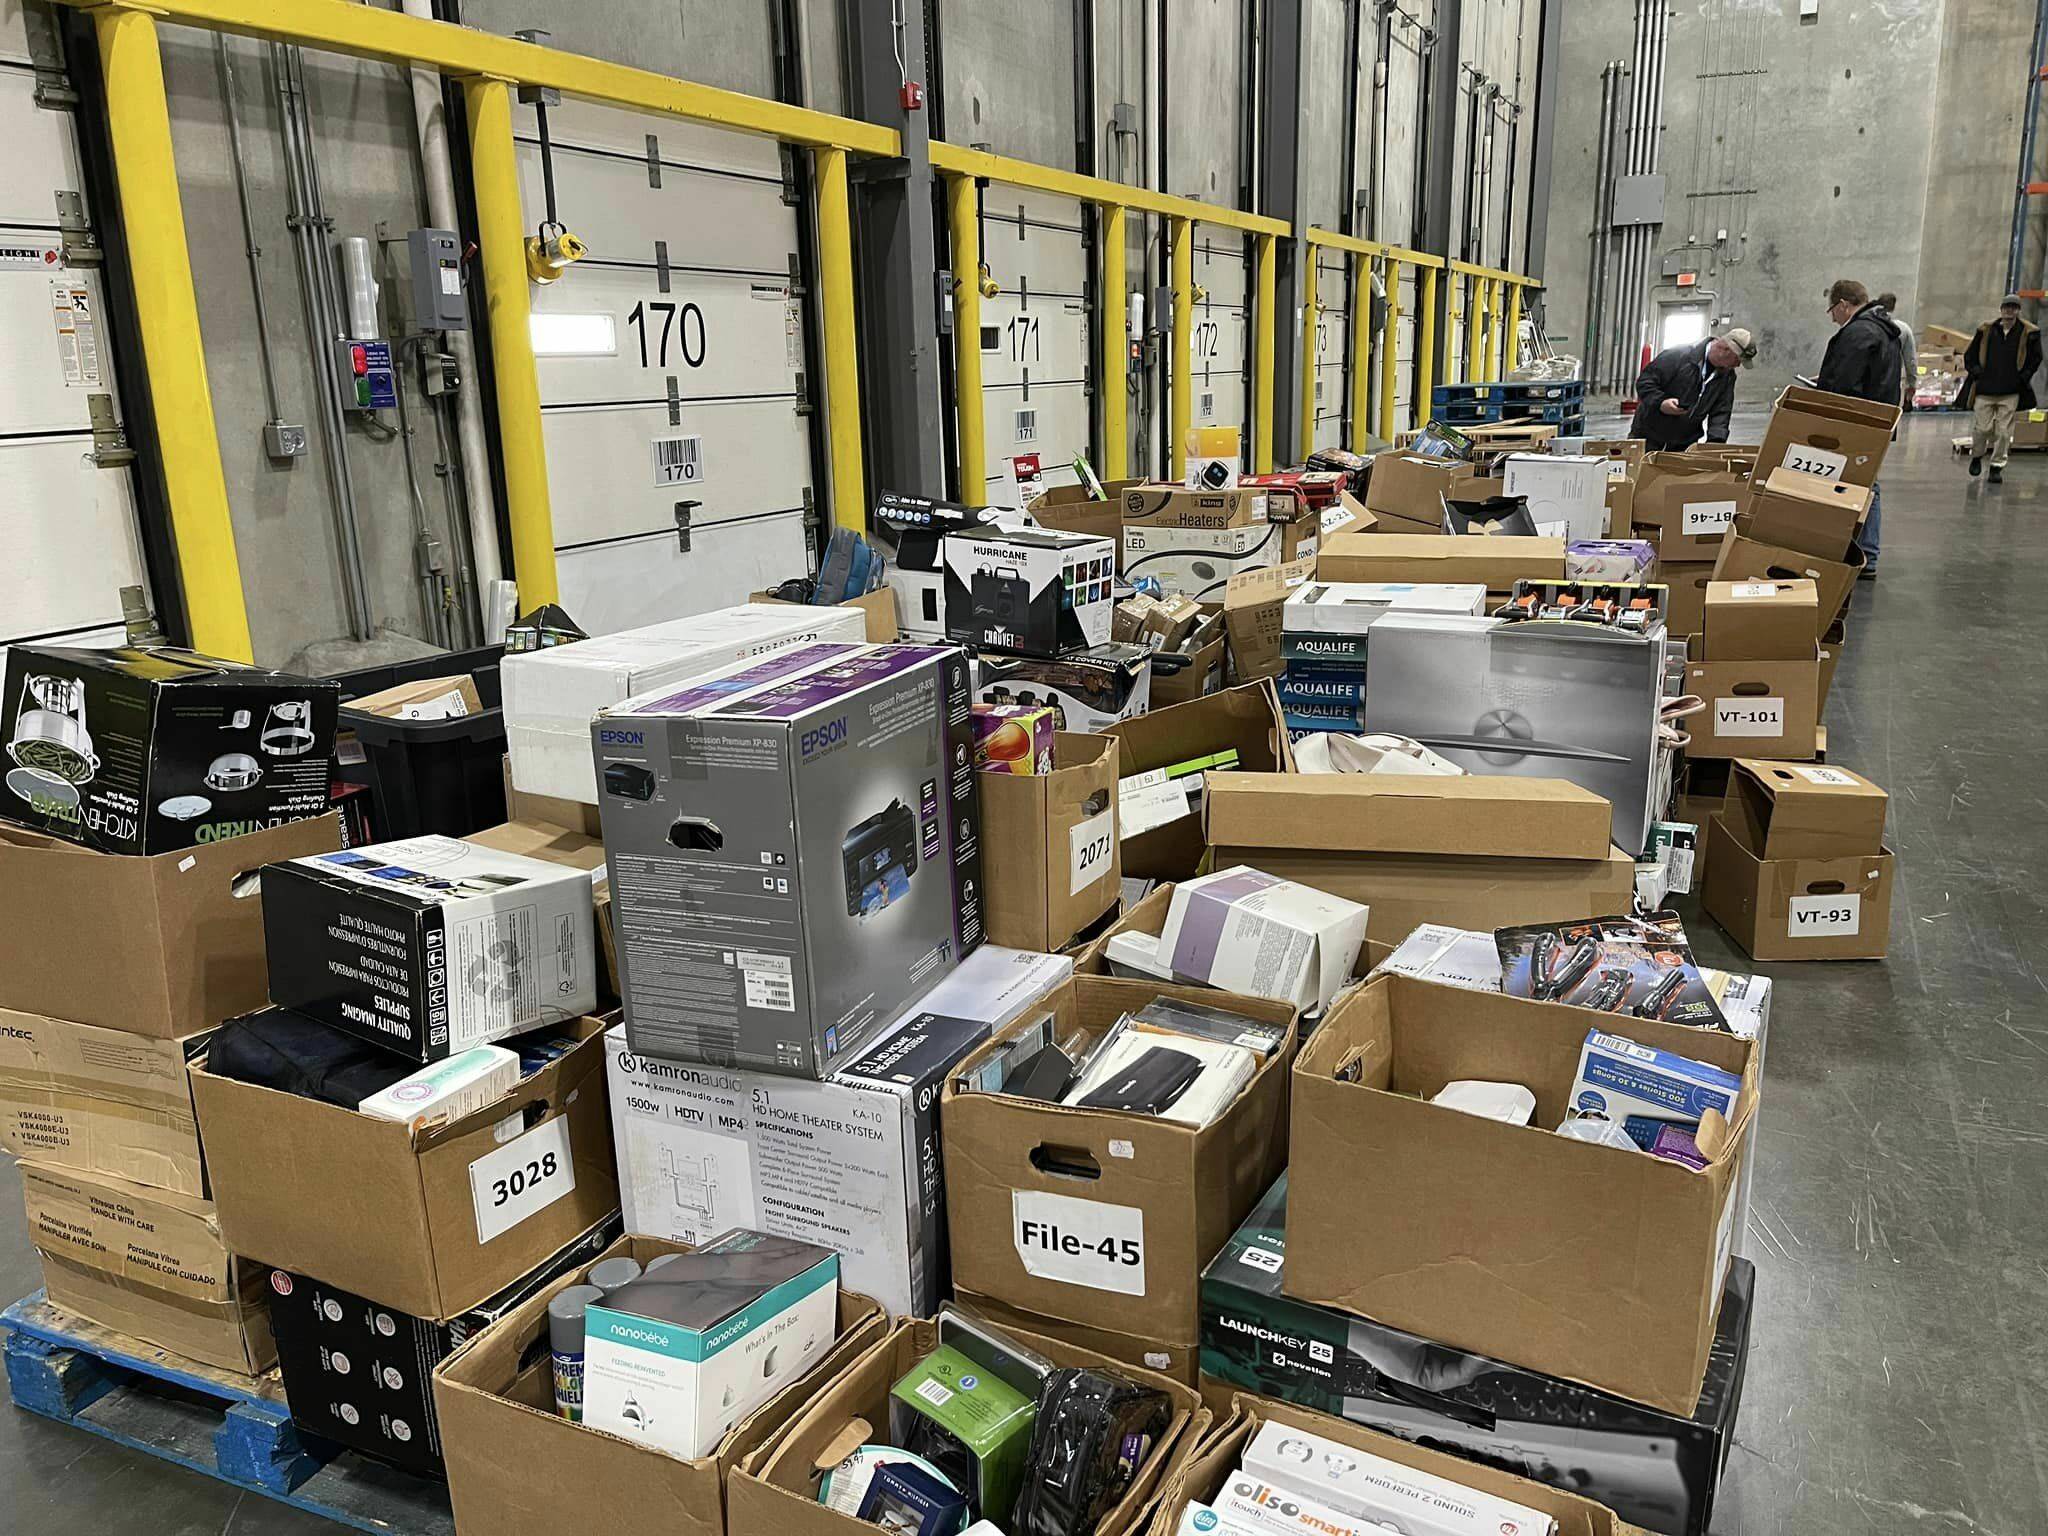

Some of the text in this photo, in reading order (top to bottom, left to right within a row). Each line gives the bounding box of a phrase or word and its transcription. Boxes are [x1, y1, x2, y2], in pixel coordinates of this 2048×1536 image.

[628, 301, 706, 368] 170
[1007, 316, 1040, 362] 171
[1196, 322, 1218, 357] 172
[1018, 428, 1034, 440] 171
[664, 463, 695, 481] 170
[1791, 457, 1836, 477] 2127
[1179, 513, 1225, 527] Heaters
[973, 546, 1028, 560] HURRICANE
[1126, 539, 1146, 549] LED
[1234, 541, 1246, 553] LED
[1295, 641, 1357, 654] AQUALIFE
[1283, 682, 1354, 697] AQUALIFE
[869, 698, 895, 716] Expression
[1282, 702, 1351, 718] AQUALIFE
[1719, 711, 1779, 724] VT-101
[600, 730, 643, 744] EPSON
[685, 734, 777, 748] Expression Premium XP-830
[801, 716, 848, 756] EPSON
[1079, 836, 1112, 870] 2071
[1796, 909, 1852, 923] VT-93
[364, 920, 384, 937] HAUTE
[384, 926, 406, 944] PHOTO
[366, 937, 407, 961] FOURNITURES
[359, 970, 374, 985] PARA
[360, 955, 408, 981] DE ALTA CALIDAD
[373, 975, 409, 998] PRODUCTOS
[374, 995, 410, 1020] SUPPLIES
[341, 1002, 412, 1040] QUALITY IMAGING
[855, 1035, 913, 1073] 5.1 HD HOME
[868, 1034, 929, 1075] THEATER SYSTEM
[639, 1057, 743, 1092] kamronaudio
[1592, 1068, 1617, 1082] Songs
[1618, 1077, 1628, 1086] 30
[630, 1080, 735, 1106] www.kamronaudio.com
[751, 1088, 770, 1104] 5.1
[1638, 1083, 1667, 1099] Stories
[1668, 1094, 1686, 1104] 500
[626, 1096, 744, 1130] 1500w HDTV MP4
[752, 1104, 884, 1141] HD HOME THEATER SYSTEM
[852, 1108, 882, 1123] KA-10
[755, 1120, 814, 1139] SPECIFICATIONS
[492, 1151, 557, 1207] 3028
[116, 1204, 135, 1216] China
[762, 1196, 825, 1218] CONFIGURATION
[90, 1206, 155, 1233] HANDLE WITH CARE
[765, 1208, 851, 1236] FRONT SURROUND SPEAKERS
[39, 1222, 71, 1241] MANIPULER
[72, 1235, 90, 1249] AVEC
[1021, 1221, 1141, 1266] File-45
[127, 1254, 216, 1285] MANIPULE CON CUIDADO
[1245, 1251, 1279, 1267] 25
[610, 1324, 669, 1347] nanobébé
[744, 1323, 786, 1354] What's The
[1219, 1315, 1331, 1358] LAUNCHKEY 25
[1286, 1359, 1332, 1378] novation
[1364, 1474, 1420, 1498] PERFORM
[1234, 1482, 1300, 1517] oliso
[1433, 1498, 1476, 1519] SOUND
